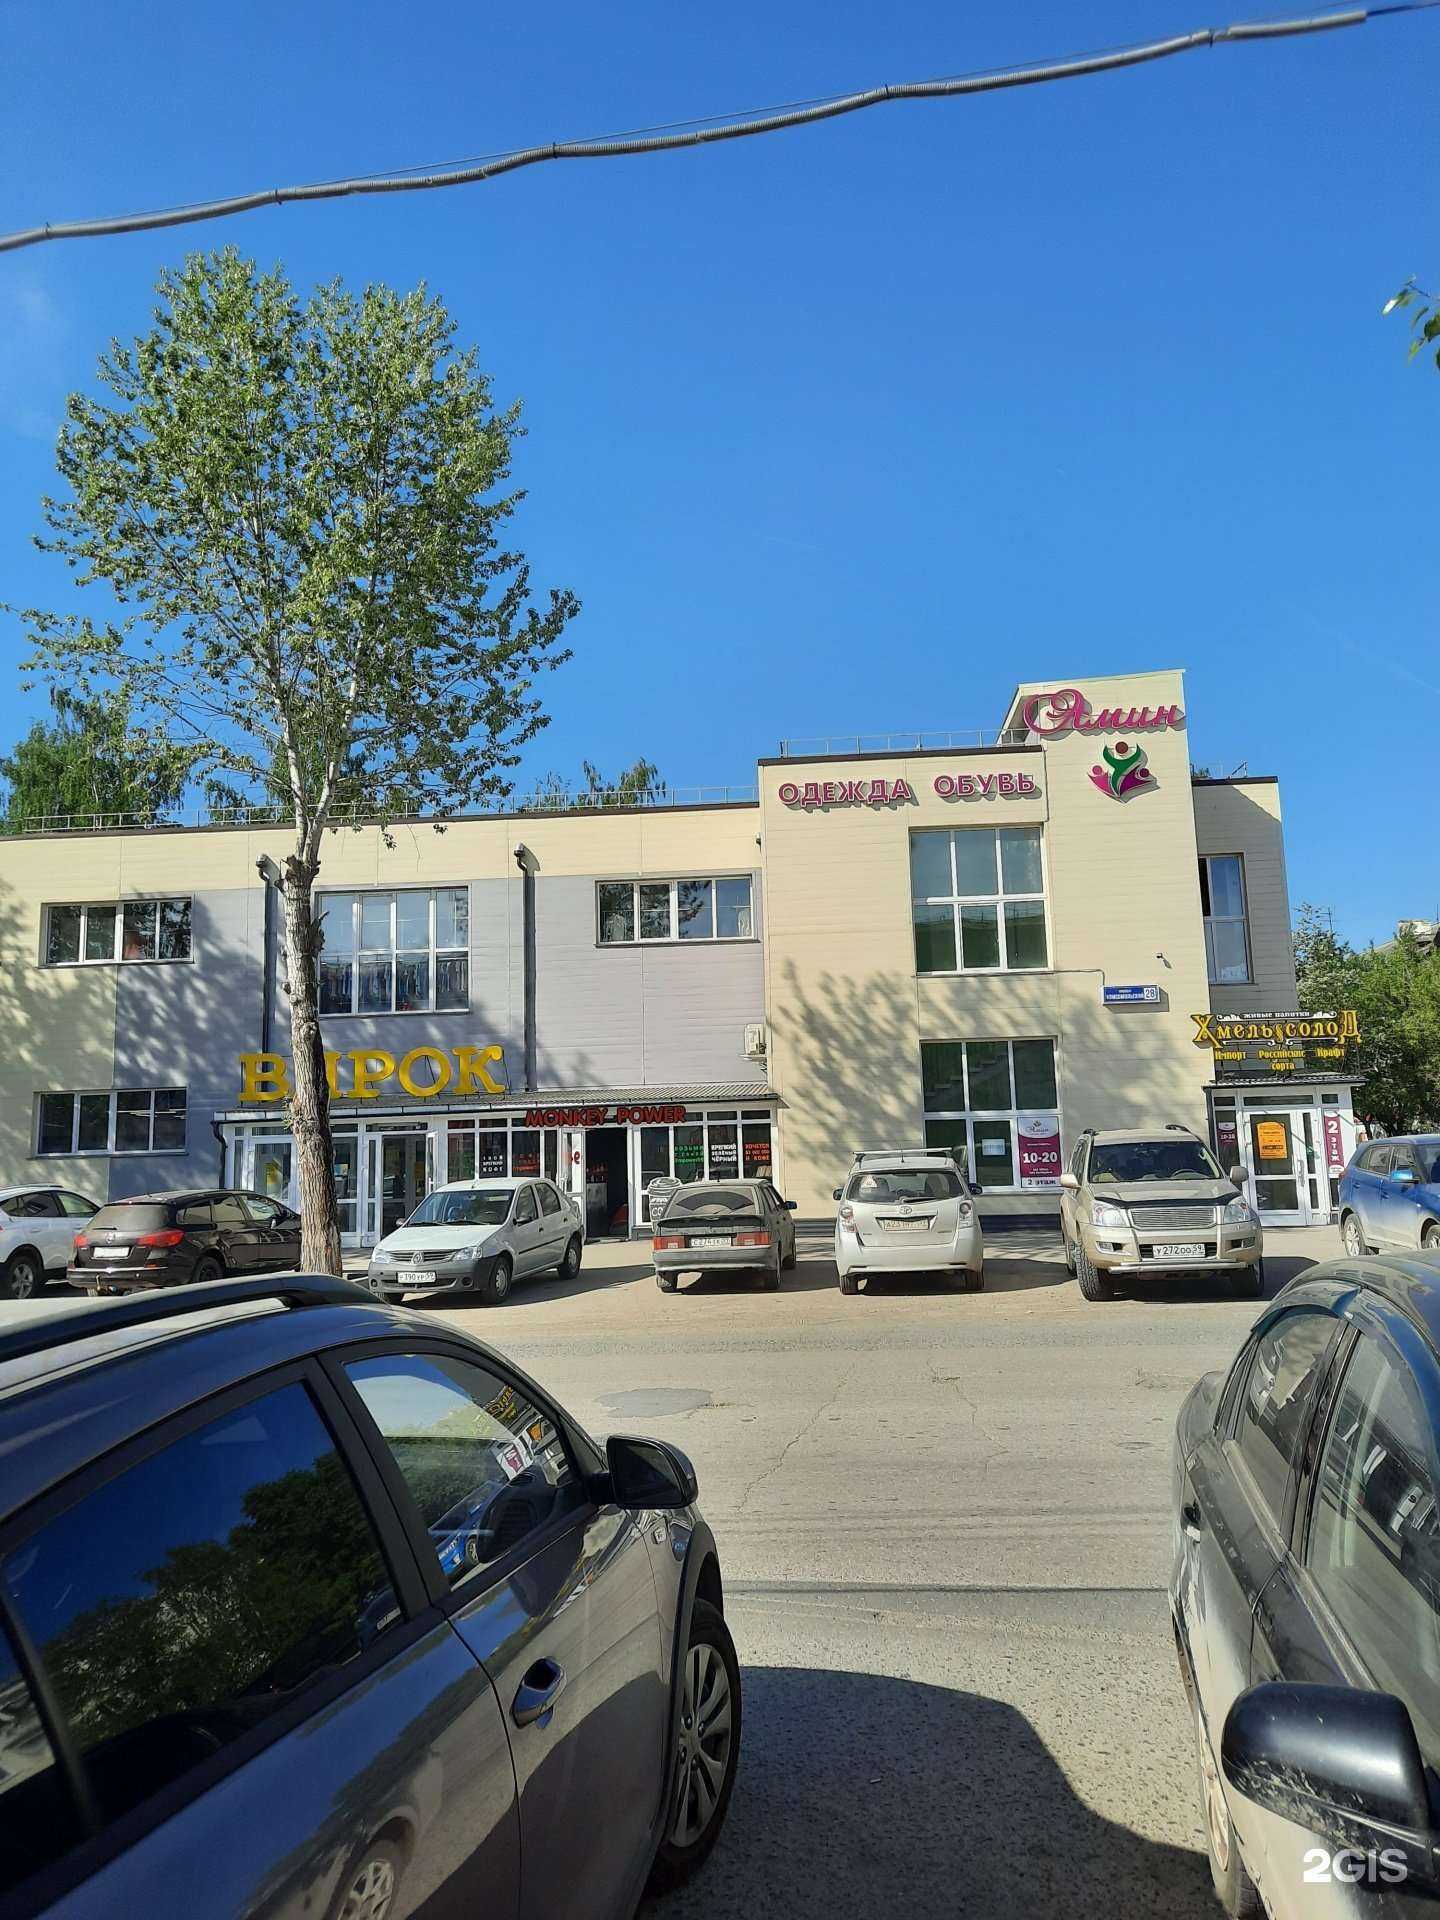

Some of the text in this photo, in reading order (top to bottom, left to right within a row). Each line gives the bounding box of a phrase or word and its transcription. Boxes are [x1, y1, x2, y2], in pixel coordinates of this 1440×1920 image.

[778, 771, 1037, 807] ОДЕЖДА ОБУВЬ
[1145, 988, 1155, 999] 28
[524, 1105, 687, 1128] MONKEY POWER
[1327, 1120, 1338, 1134] 2
[1023, 1151, 1057, 1164] 10-20
